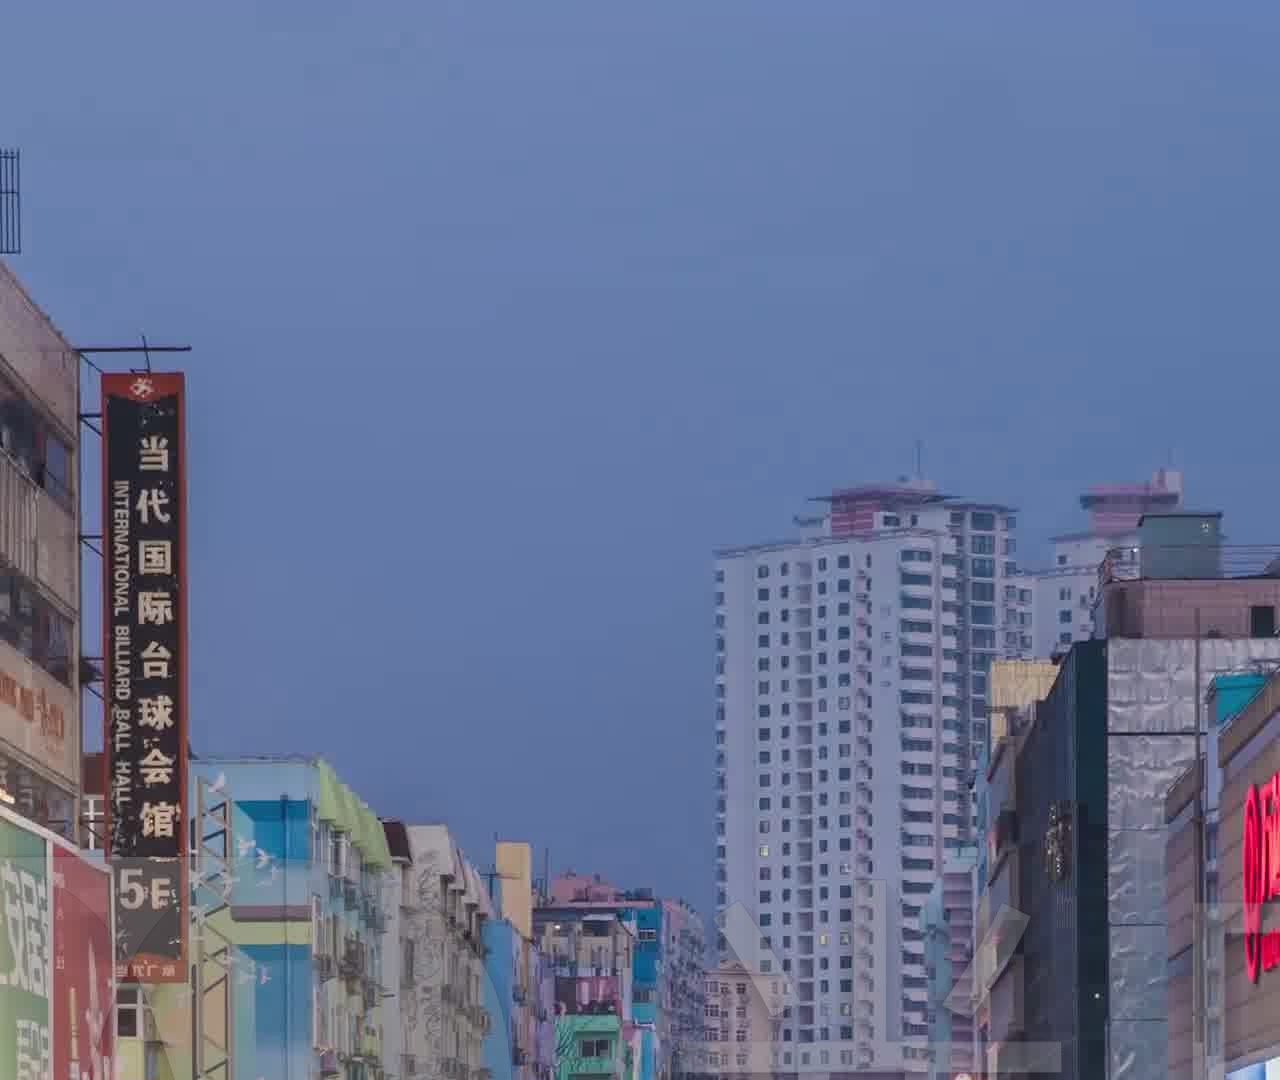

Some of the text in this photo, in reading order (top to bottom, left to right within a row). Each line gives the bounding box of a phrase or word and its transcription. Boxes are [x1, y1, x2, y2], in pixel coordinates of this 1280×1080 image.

[112, 480, 130, 617] INTERNATIONAL
[136, 436, 174, 838] 当代国际台球会馆
[115, 707, 131, 753] BALL
[115, 760, 131, 803] HALL
[118, 868, 171, 911] 5F
